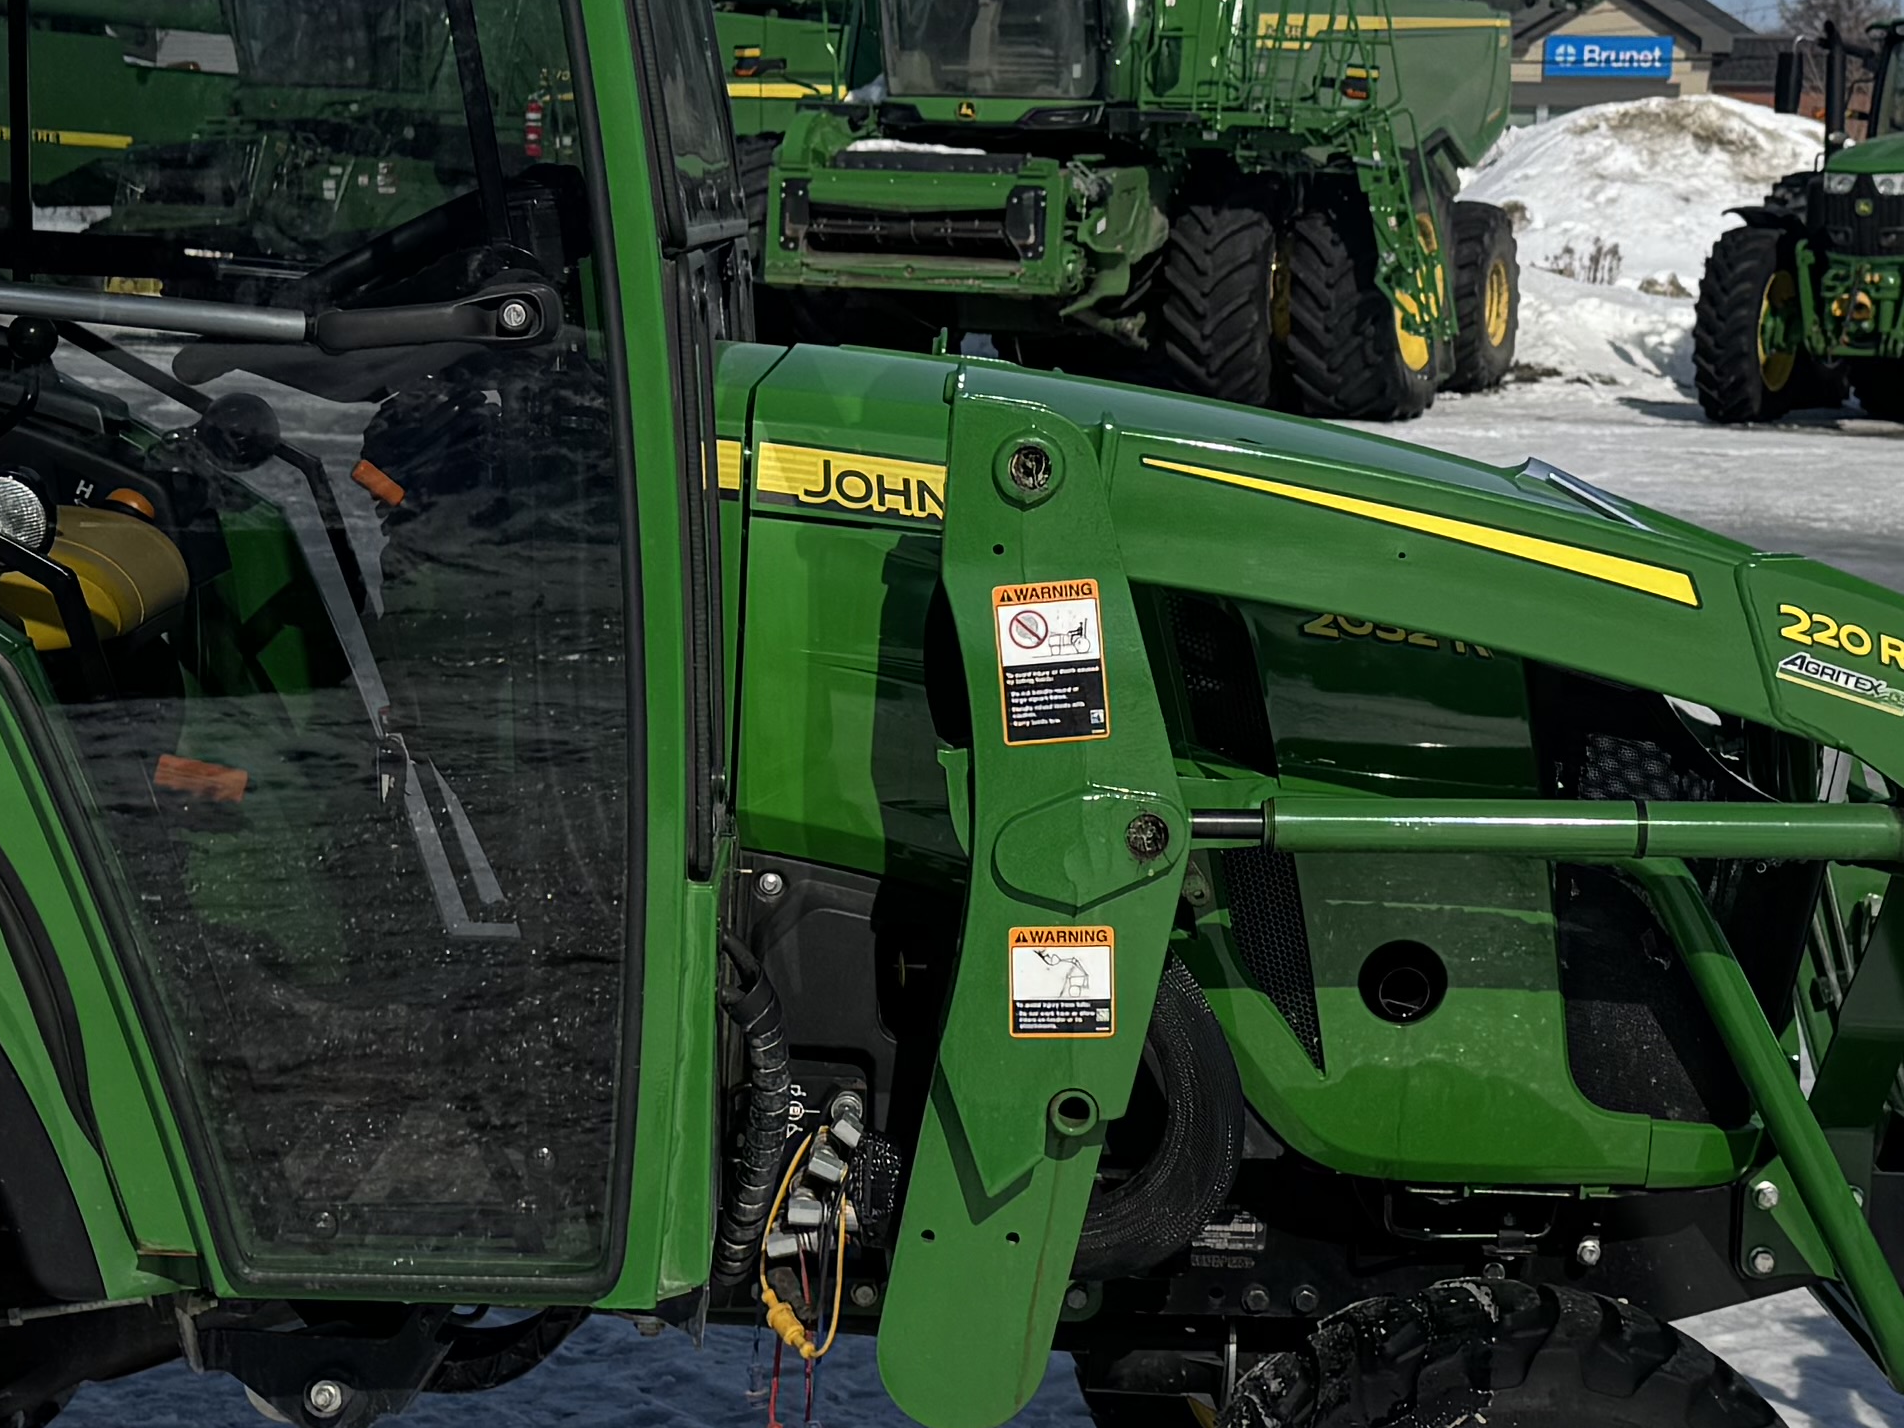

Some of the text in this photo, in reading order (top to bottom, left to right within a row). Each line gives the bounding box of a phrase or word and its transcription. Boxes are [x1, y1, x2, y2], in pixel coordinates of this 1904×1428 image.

[1583, 45, 1663, 68] Brunet
[805, 459, 944, 514] JOHN
[1014, 582, 1093, 601] WARNING
[1777, 603, 1872, 657] 220
[1784, 652, 1887, 697] AGRITEX
[1030, 930, 1108, 943] WARNING
